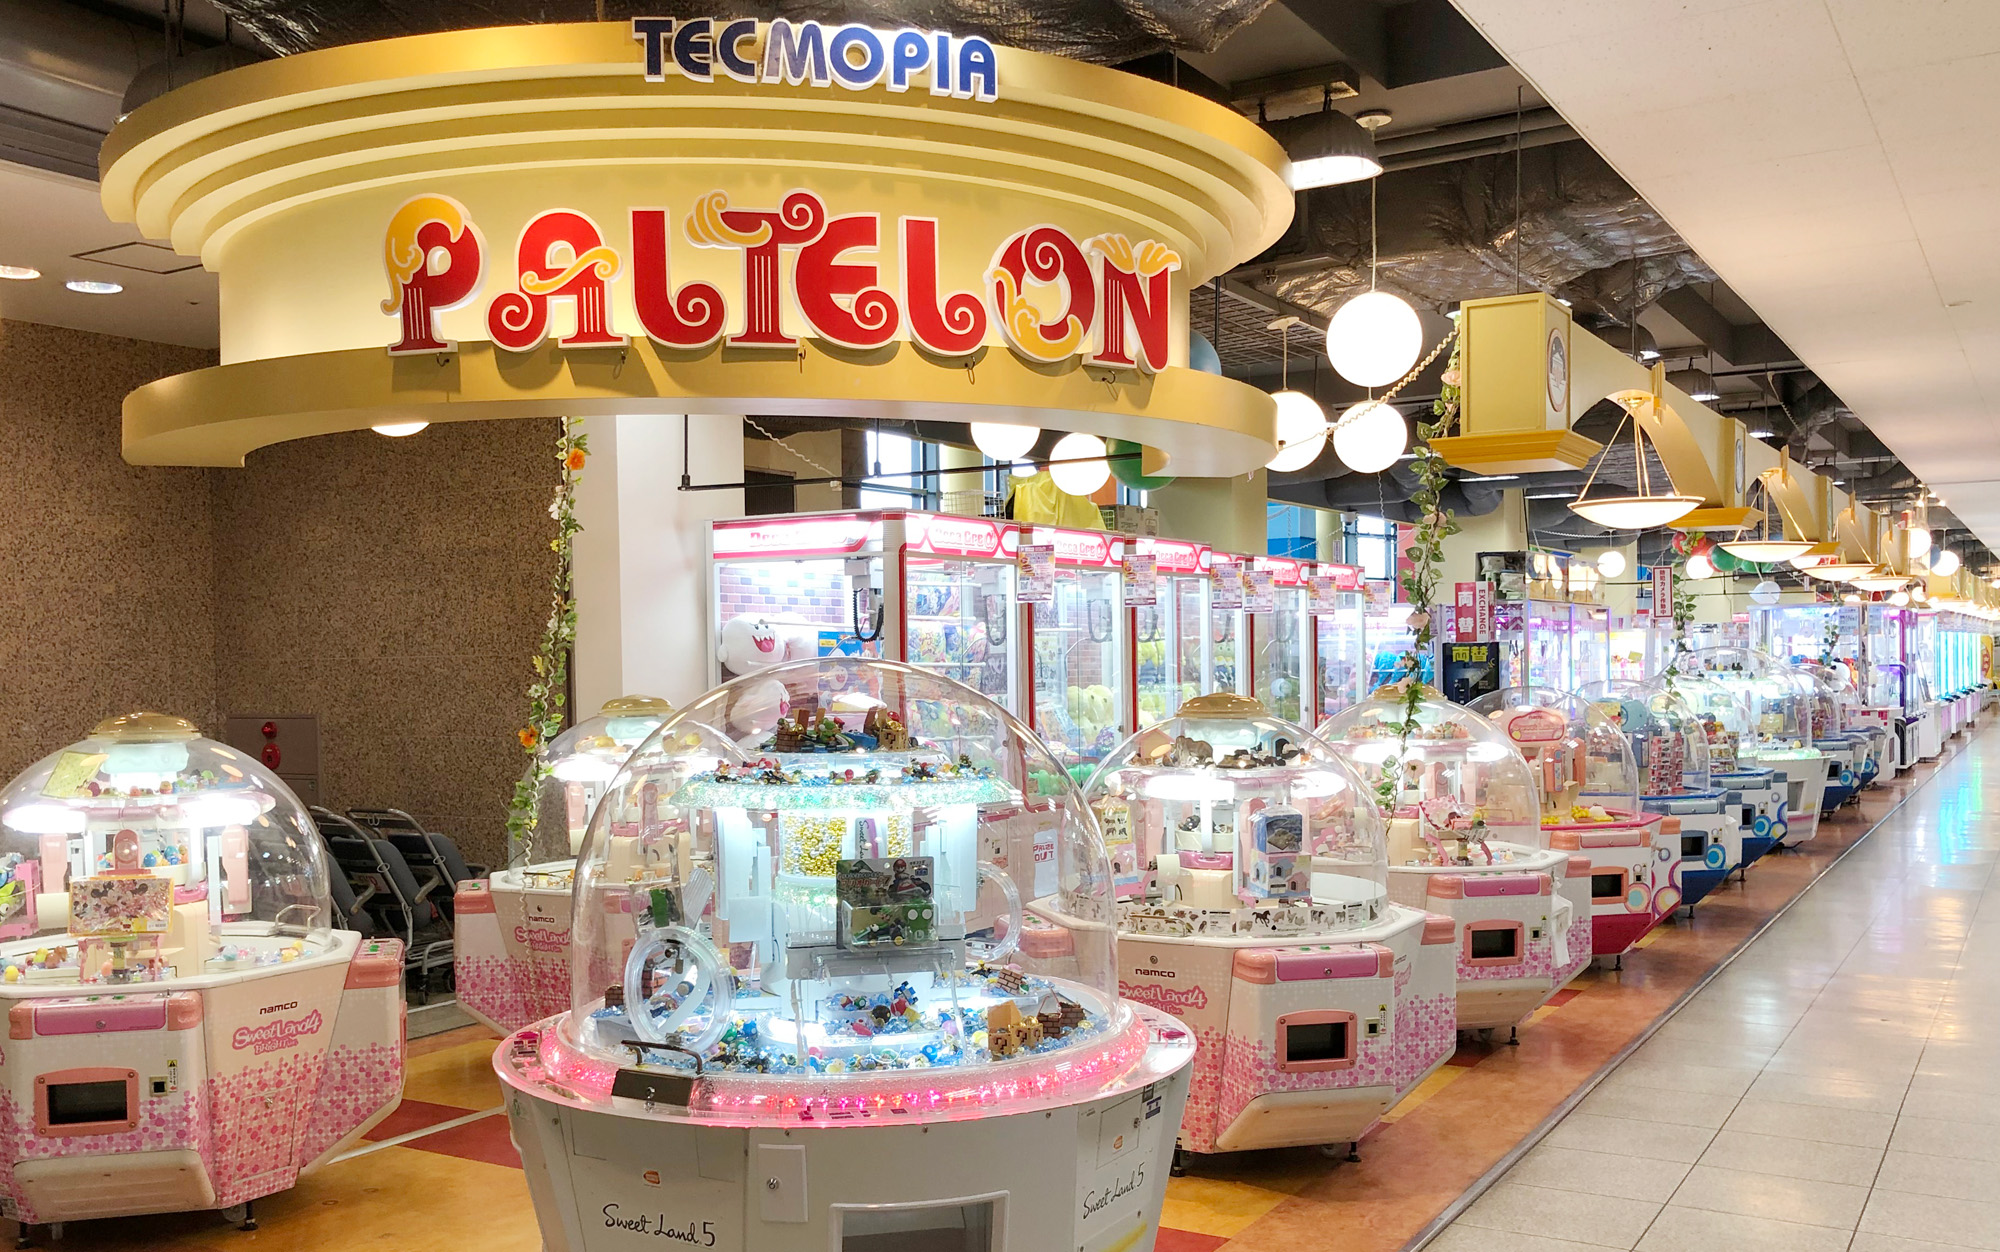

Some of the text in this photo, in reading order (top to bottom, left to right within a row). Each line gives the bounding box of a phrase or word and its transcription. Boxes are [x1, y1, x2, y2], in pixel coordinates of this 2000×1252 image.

[634, 17, 998, 101] TECMOPIA
[381, 187, 1182, 375] PALTELON
[1457, 591, 1475, 634] 両替
[1478, 589, 1486, 635] EXCHANGE
[1452, 645, 1488, 662] 両替
[1033, 843, 1054, 853] PRIZE
[1034, 850, 1054, 862] OUT
[528, 915, 555, 923] namco
[1135, 968, 1176, 978] namco
[259, 1001, 298, 1015] namco
[1083, 1162, 1145, 1220] Sweet Land 5
[602, 1203, 716, 1247] Sweet Land 5
